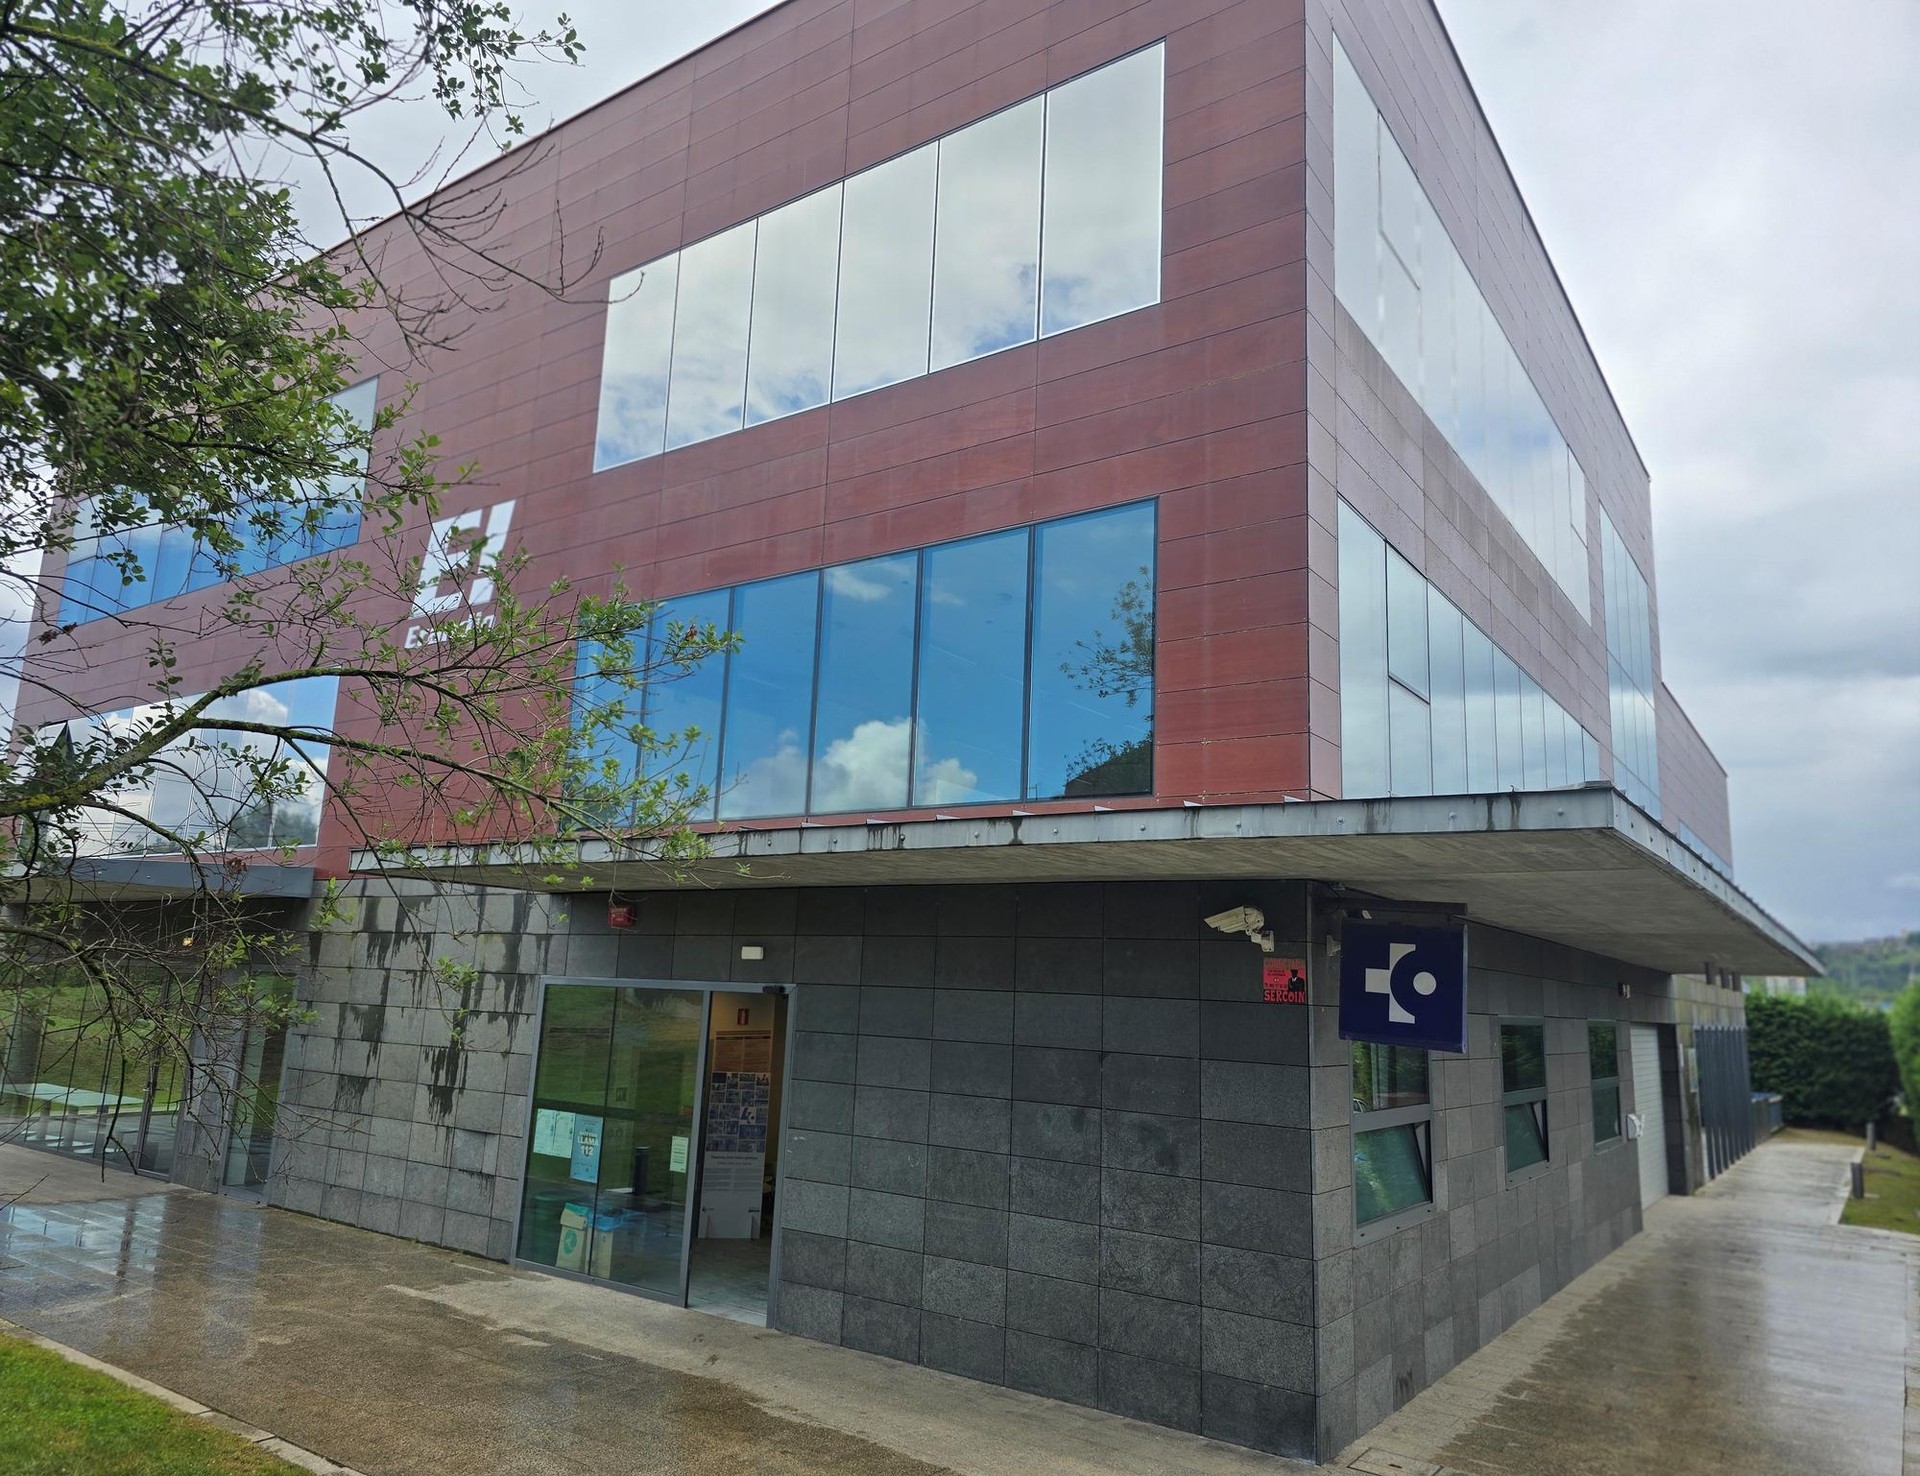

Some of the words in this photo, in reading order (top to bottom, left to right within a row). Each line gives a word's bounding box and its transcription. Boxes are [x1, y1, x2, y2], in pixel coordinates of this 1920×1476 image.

[1264, 990, 1305, 1003] SERCOIN
[577, 1135, 599, 1146] LLAMA
[580, 1145, 594, 1156] 112
